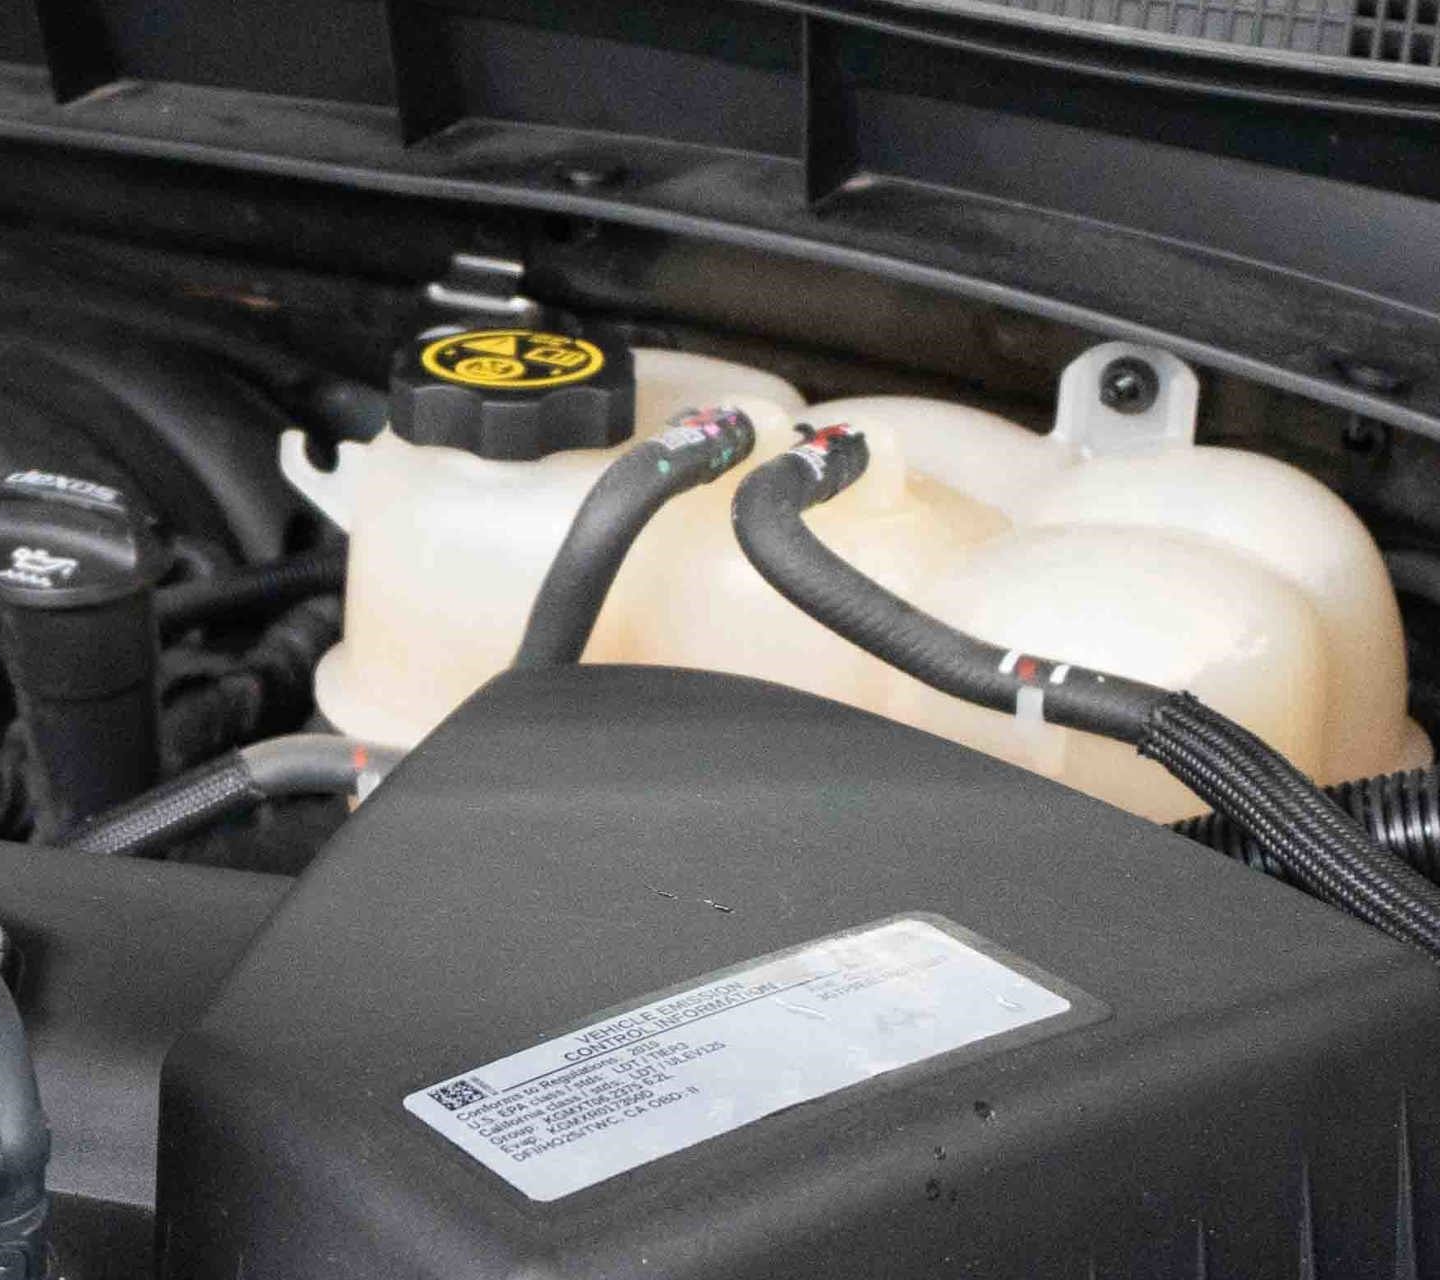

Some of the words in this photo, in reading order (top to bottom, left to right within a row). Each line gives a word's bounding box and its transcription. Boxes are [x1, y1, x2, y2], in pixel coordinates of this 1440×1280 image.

[563, 1028, 654, 1061] CONTROL
[653, 981, 780, 1029] INFORMATION
[574, 1011, 657, 1044] VEHICLE
[655, 981, 745, 1016] EMISSION
